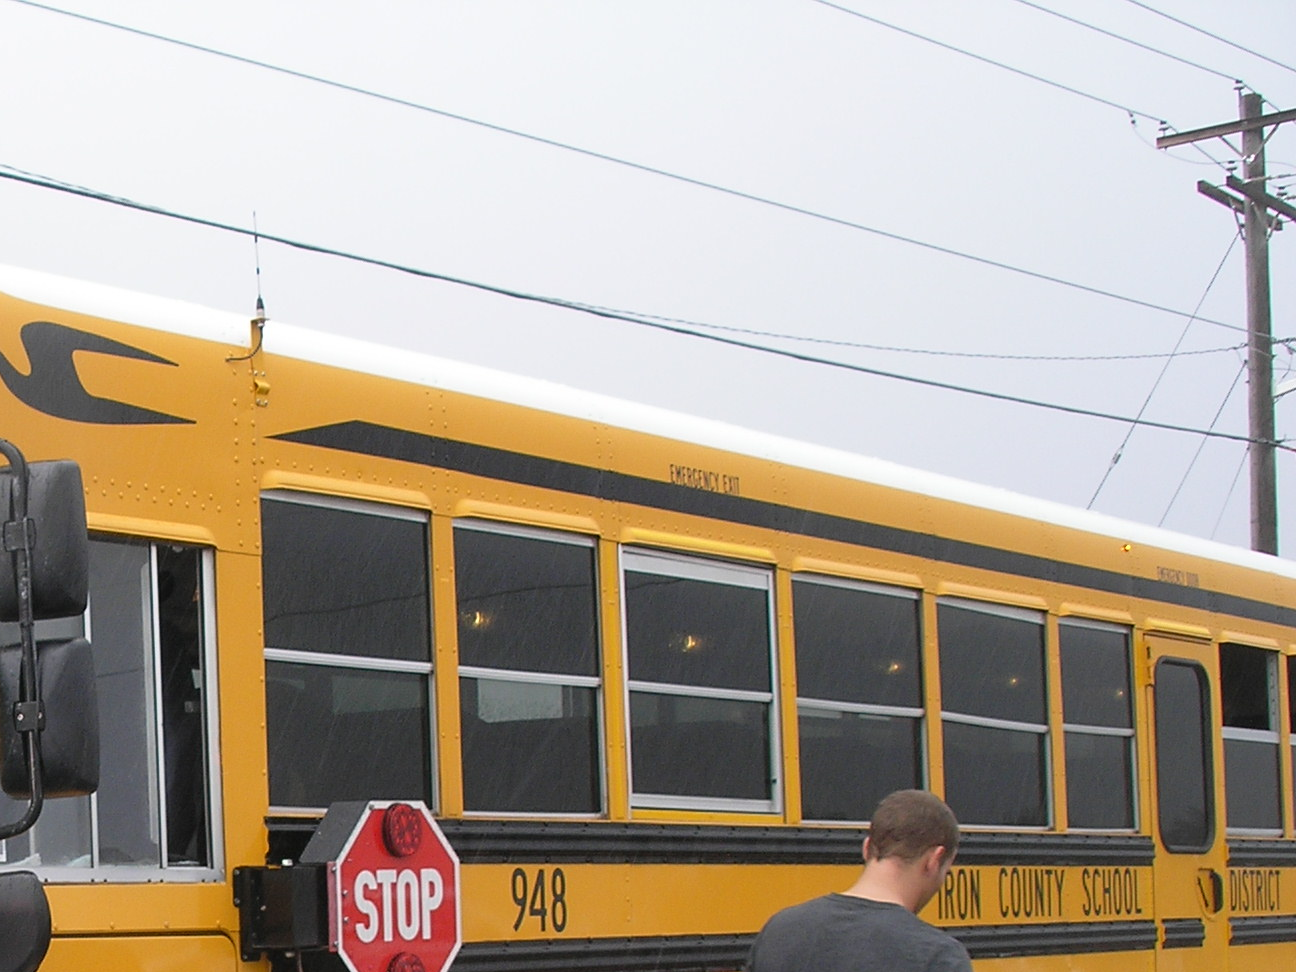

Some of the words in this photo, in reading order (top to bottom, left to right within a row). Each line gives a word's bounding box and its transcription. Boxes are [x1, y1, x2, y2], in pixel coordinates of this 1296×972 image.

[670, 464, 719, 491] EMERGENCY
[723, 474, 740, 496] EXIT
[354, 868, 444, 943] STOP
[511, 867, 567, 932] 948
[938, 869, 981, 920] IRON
[999, 867, 1065, 918] COUNTY
[1082, 868, 1142, 915] SCHOOL
[1230, 870, 1281, 911] DISTRICT
